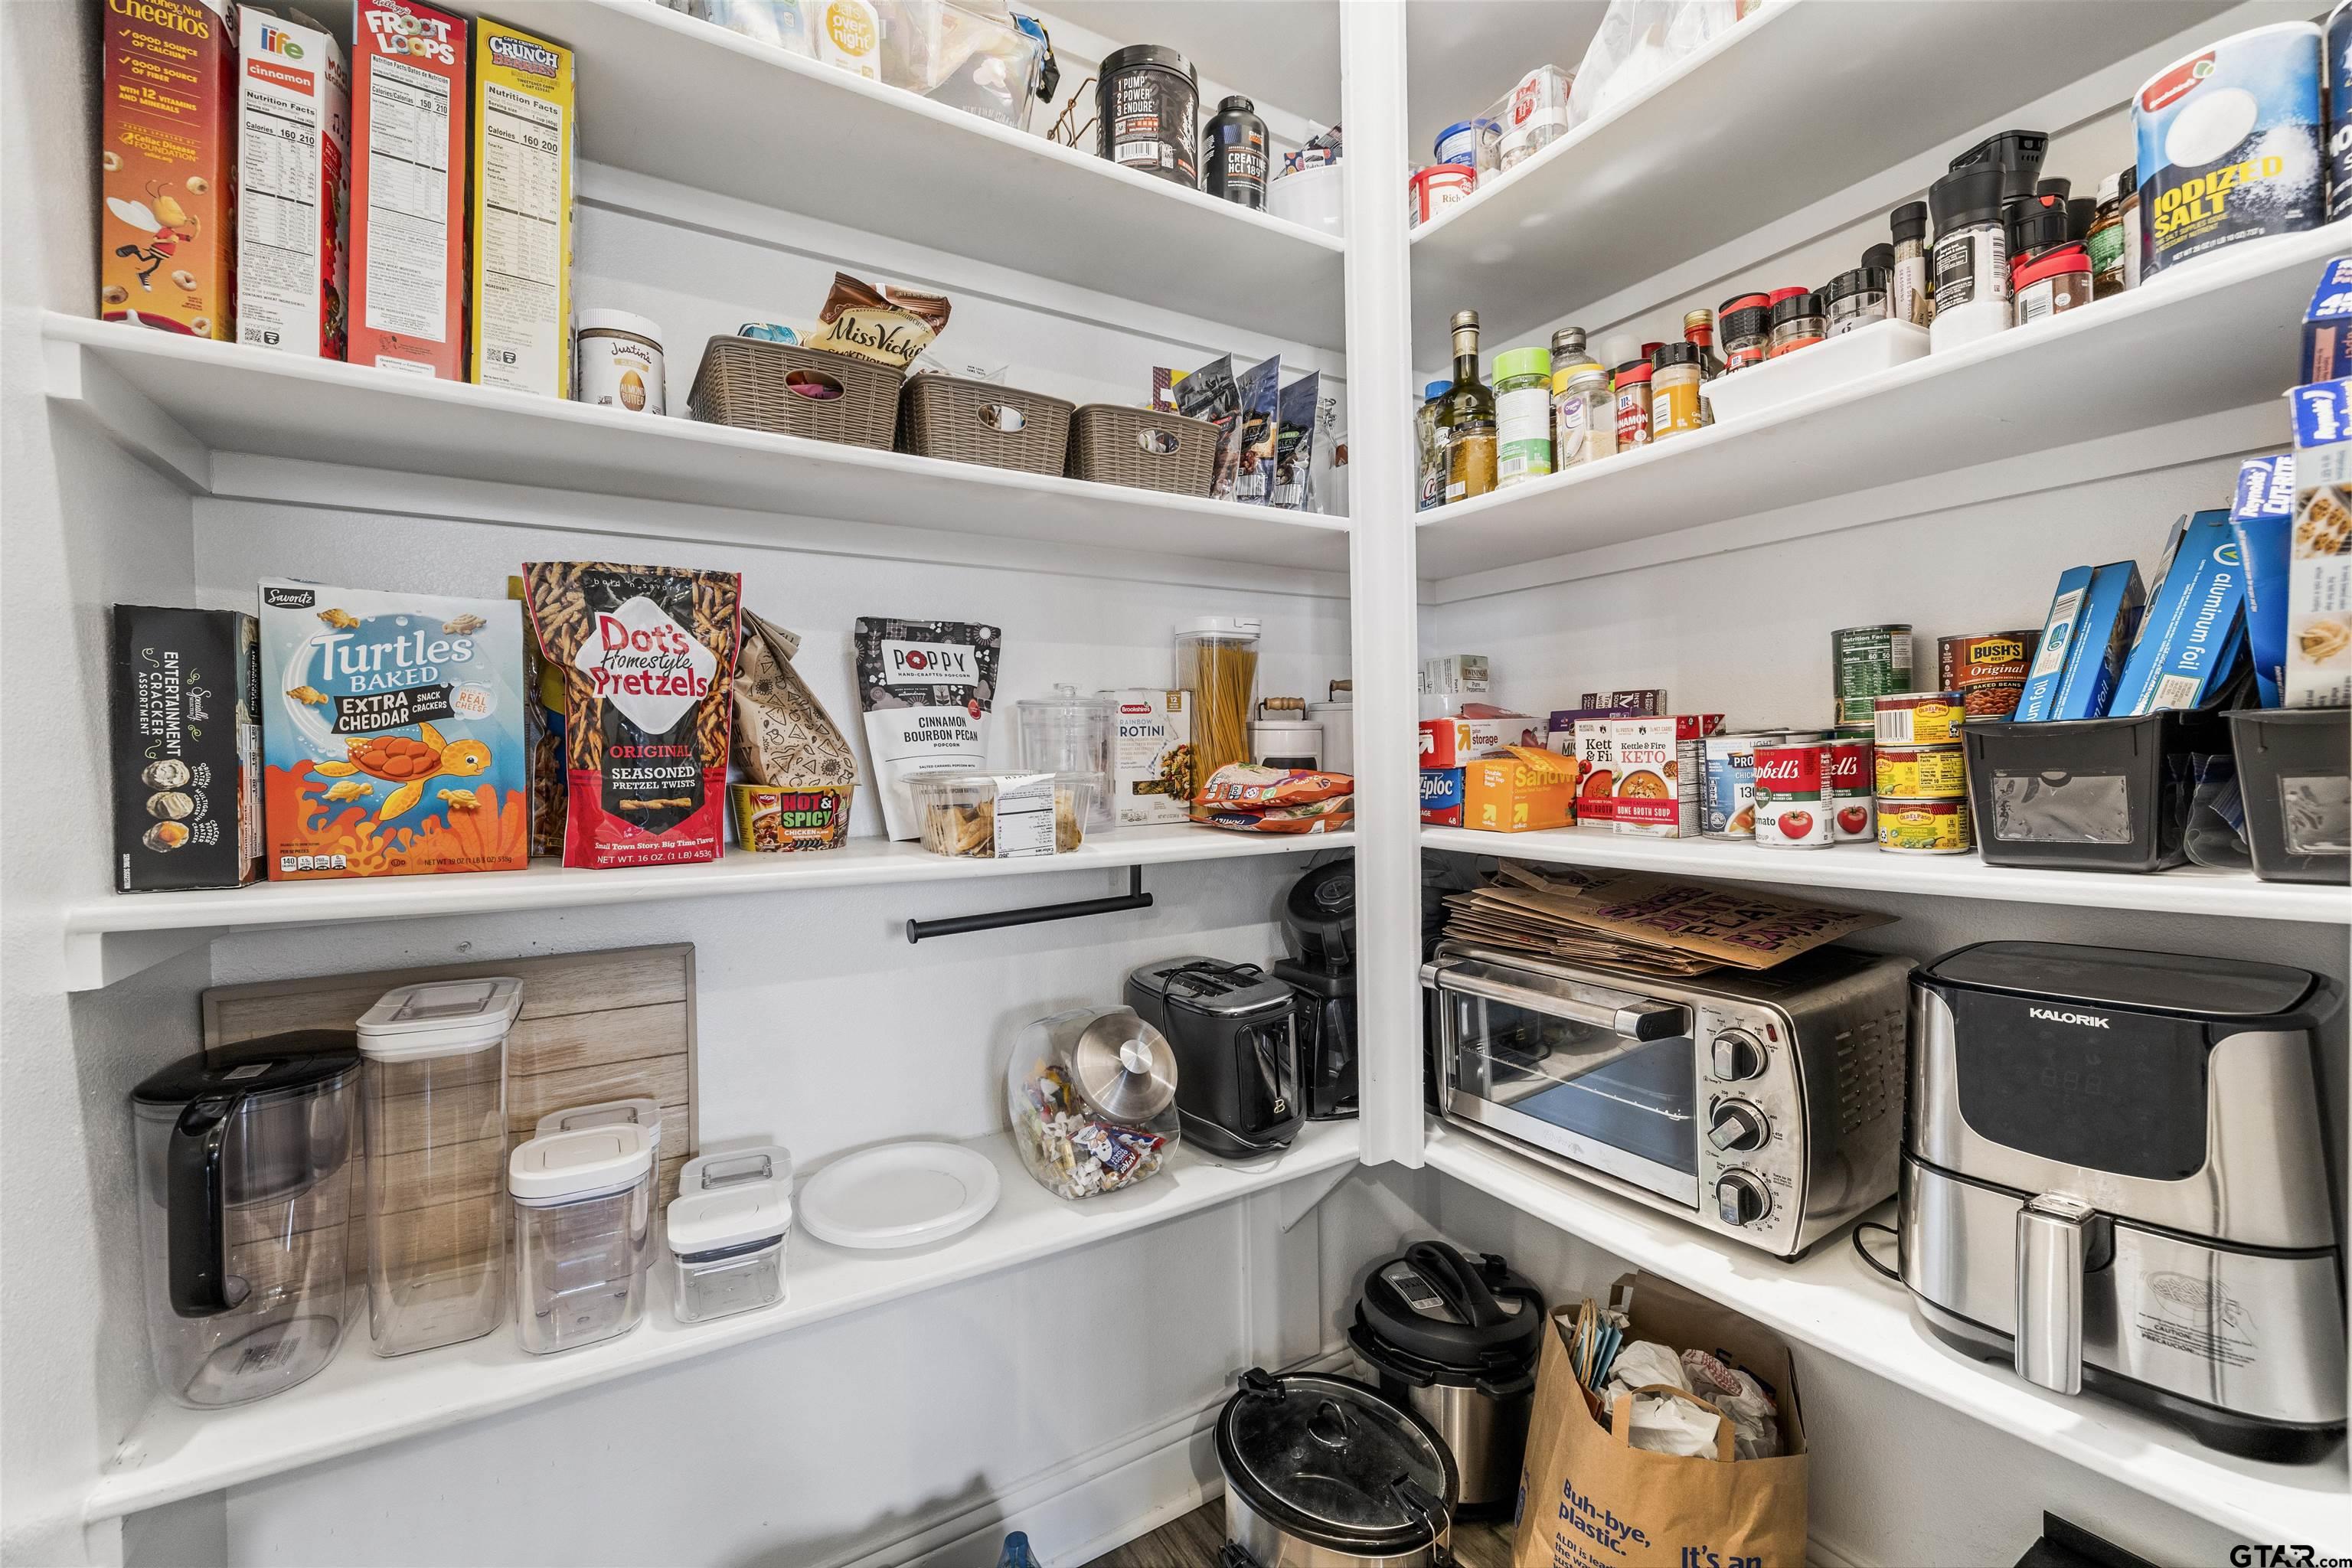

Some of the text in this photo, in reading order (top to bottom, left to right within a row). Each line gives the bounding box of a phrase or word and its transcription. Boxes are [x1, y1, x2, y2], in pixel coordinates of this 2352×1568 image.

[109, 0, 209, 39] Cheerios
[365, 10, 451, 43] FROOT
[132, 32, 198, 57] GOOD SOURCE
[146, 44, 186, 60] CALCIUM
[261, 28, 304, 59] life
[376, 33, 455, 65] LOOPS
[489, 37, 558, 68] CRUNCH
[132, 59, 198, 83] GOOD SOURCE
[147, 71, 169, 83] FIBER
[250, 64, 311, 87] cinnamon
[492, 53, 556, 78] BERRIES
[119, 85, 197, 111] WITH 12 VITAMINS
[119, 93, 180, 114] AND MINERALS
[247, 91, 315, 116] Nutrition Facts
[488, 86, 558, 116] Nutrition Facts
[246, 121, 315, 145] Calories 160 210
[488, 125, 557, 152] Calories 160 200
[135, 142, 194, 162] FOUNDATION
[1229, 153, 1266, 172] CREATINE
[2154, 155, 2283, 218] IODIZED
[1442, 194, 1461, 203] Rich
[2154, 189, 2230, 238] SALT
[827, 317, 927, 361] Miss Vickie'
[611, 342, 652, 364] Justin's
[620, 383, 645, 395] ALMOND
[622, 392, 645, 406] BUTTER
[268, 589, 312, 604] Savoritz
[2177, 573, 2233, 671] aluminum foil
[599, 615, 690, 653] Dot's
[310, 630, 474, 681] Turtles
[601, 649, 693, 677] Homestyle
[893, 649, 965, 672] POPPY
[1974, 643, 2022, 660] BUSH'S
[349, 666, 439, 693] BAKED
[589, 666, 708, 697] Pretzels
[1465, 668, 1486, 677] TWININGS
[1971, 664, 2025, 676] Original
[343, 691, 408, 714] EXTRA
[416, 691, 440, 702] SNACK
[459, 694, 486, 705] REAL
[2034, 679, 2049, 703] foil
[2096, 679, 2110, 704] foil
[139, 671, 149, 735] ASSORTMENT
[150, 672, 164, 735] CRACKER
[164, 652, 181, 756] ENTERTAINMENT
[186, 686, 211, 721] Specially
[412, 702, 447, 713] CRACKERS
[456, 702, 488, 713] CHEESE
[339, 708, 410, 731] CHEDDAR
[919, 717, 966, 728] CINNAMON
[903, 730, 978, 743] BOURBON PECAN
[1120, 726, 1164, 737] ROTINI
[1472, 733, 1498, 746] storage
[609, 744, 692, 759] ORIGINAL
[1586, 739, 1612, 750] Kett
[1621, 750, 1666, 763] KETO
[201, 763, 211, 789] ORIGINAL
[612, 766, 694, 780] SEASONED
[612, 779, 695, 790] PRETZEL TWISTS
[1419, 778, 1453, 799] Ziploc
[194, 789, 208, 822] MULTIGRAIN
[782, 795, 832, 812] HOT &
[1579, 805, 1592, 813] BONE
[1617, 806, 1671, 817] BONE BROTH SOUP
[782, 811, 833, 828] SPICY
[210, 819, 220, 846] CRACKED
[597, 855, 616, 864] NET
[678, 851, 691, 860] LB)
[694, 850, 712, 858] 453g
[2029, 1008, 2110, 1029] KALORIK
[2154, 1325, 2192, 1340] CAUTION:
[1563, 1477, 1651, 1549] Buh-bye,
[1558, 1501, 1628, 1557] plastic.
[1681, 1544, 1762, 1568] It's an
